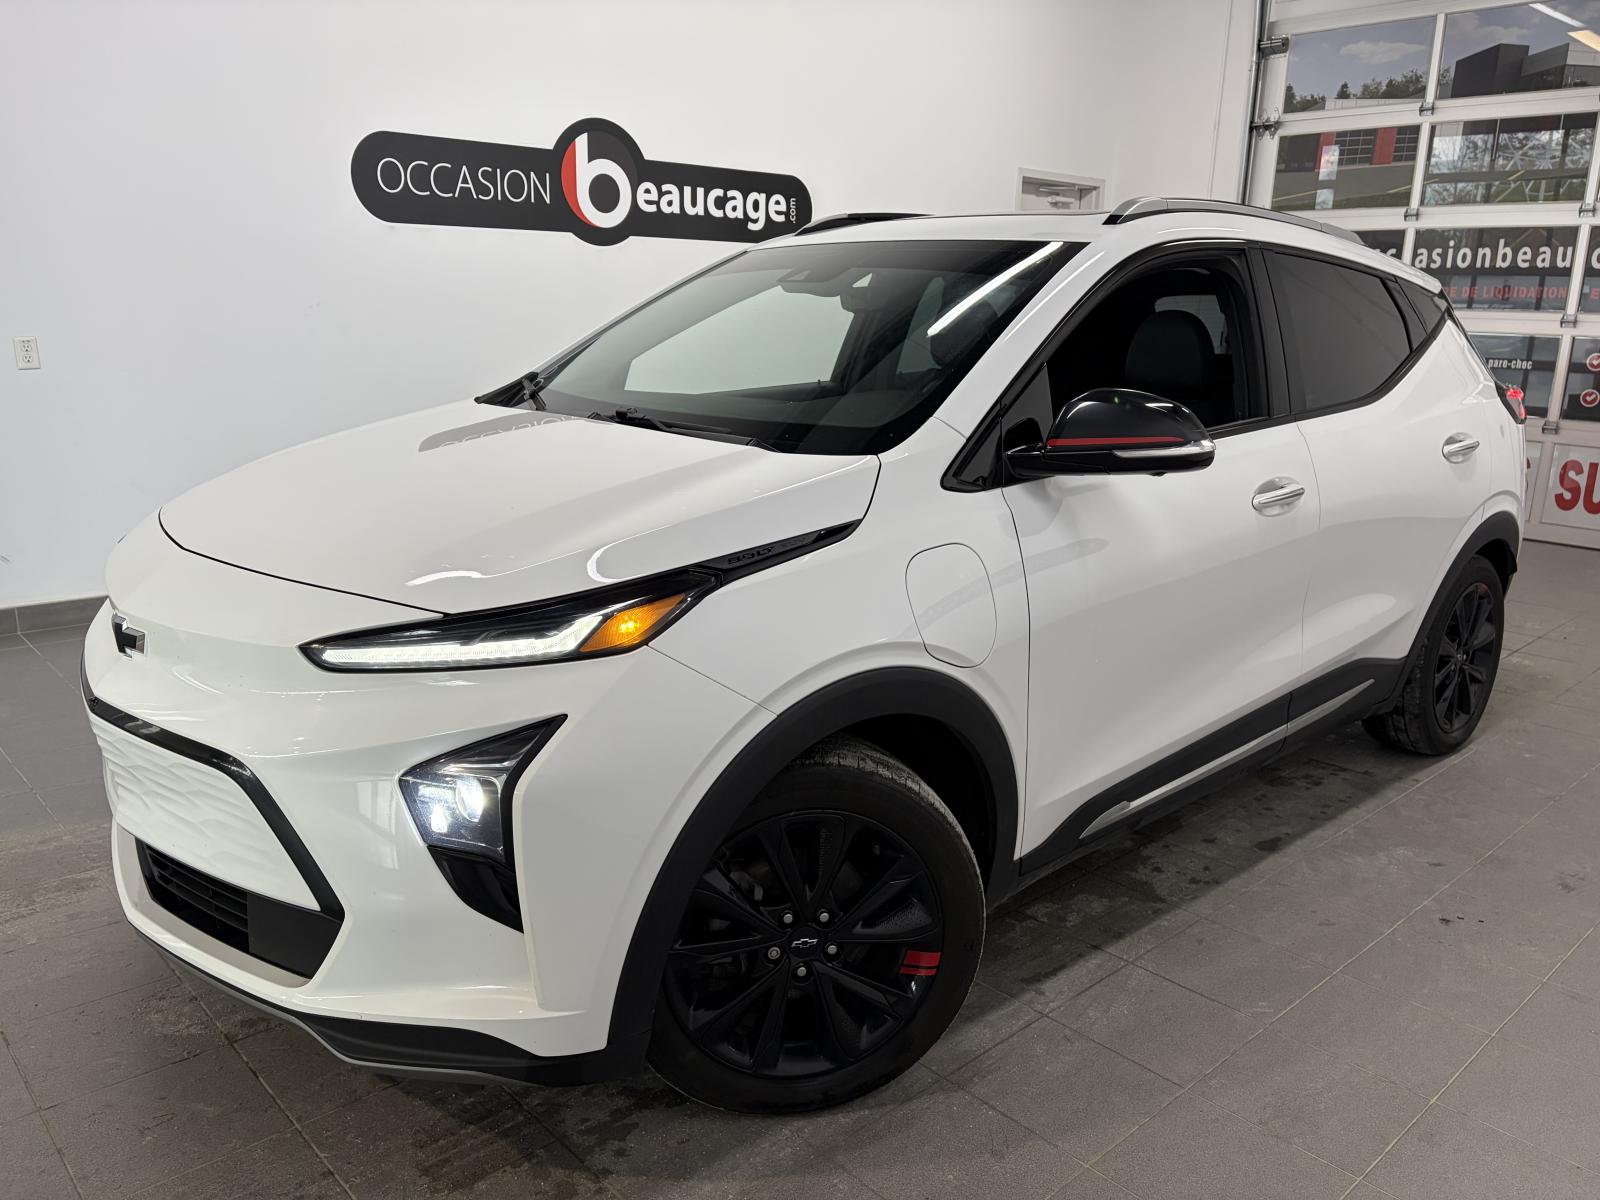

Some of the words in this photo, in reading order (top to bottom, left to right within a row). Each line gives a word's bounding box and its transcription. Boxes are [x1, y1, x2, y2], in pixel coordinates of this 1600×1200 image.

[377, 157, 551, 205] OCCASION
[789, 197, 797, 224] .com
[1462, 286, 1478, 299] DE
[1482, 285, 1568, 299] LIQUIDATION
